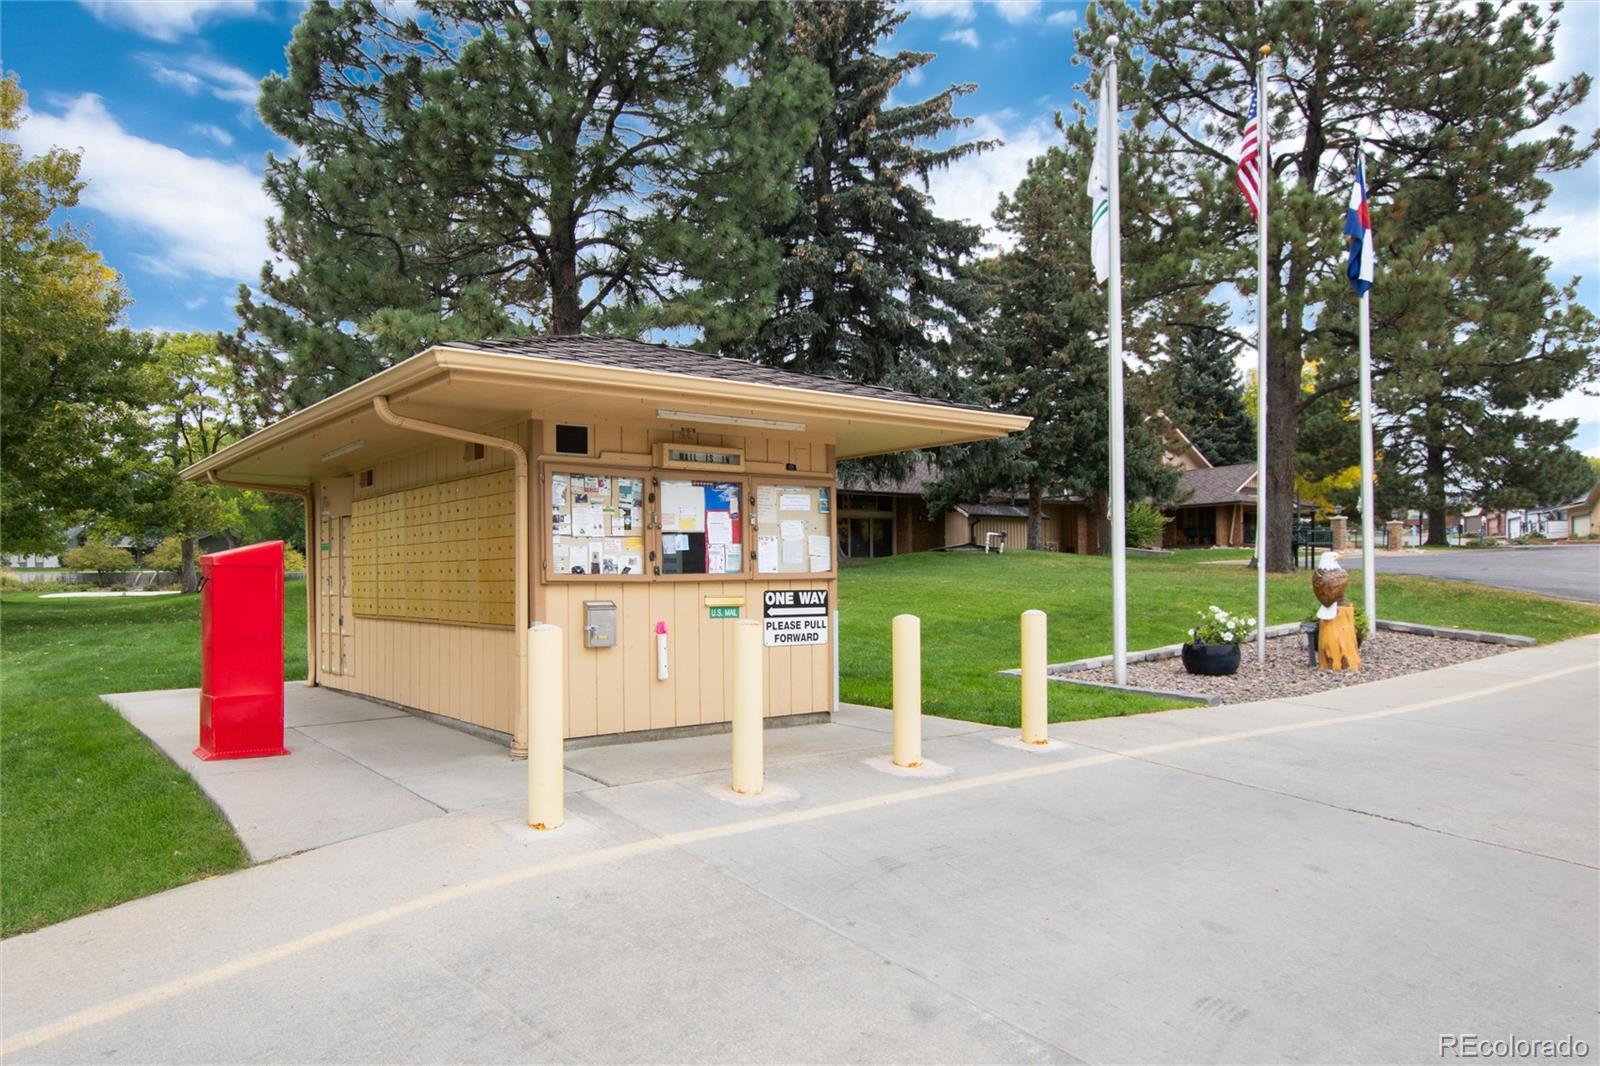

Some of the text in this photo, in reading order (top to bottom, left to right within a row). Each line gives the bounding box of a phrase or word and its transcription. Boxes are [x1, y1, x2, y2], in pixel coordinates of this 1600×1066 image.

[679, 452, 730, 464] MAIL IS IN
[765, 591, 827, 605] ONE WAY
[766, 620, 827, 631] PLEASE PULL
[774, 633, 820, 643] FORWARD
